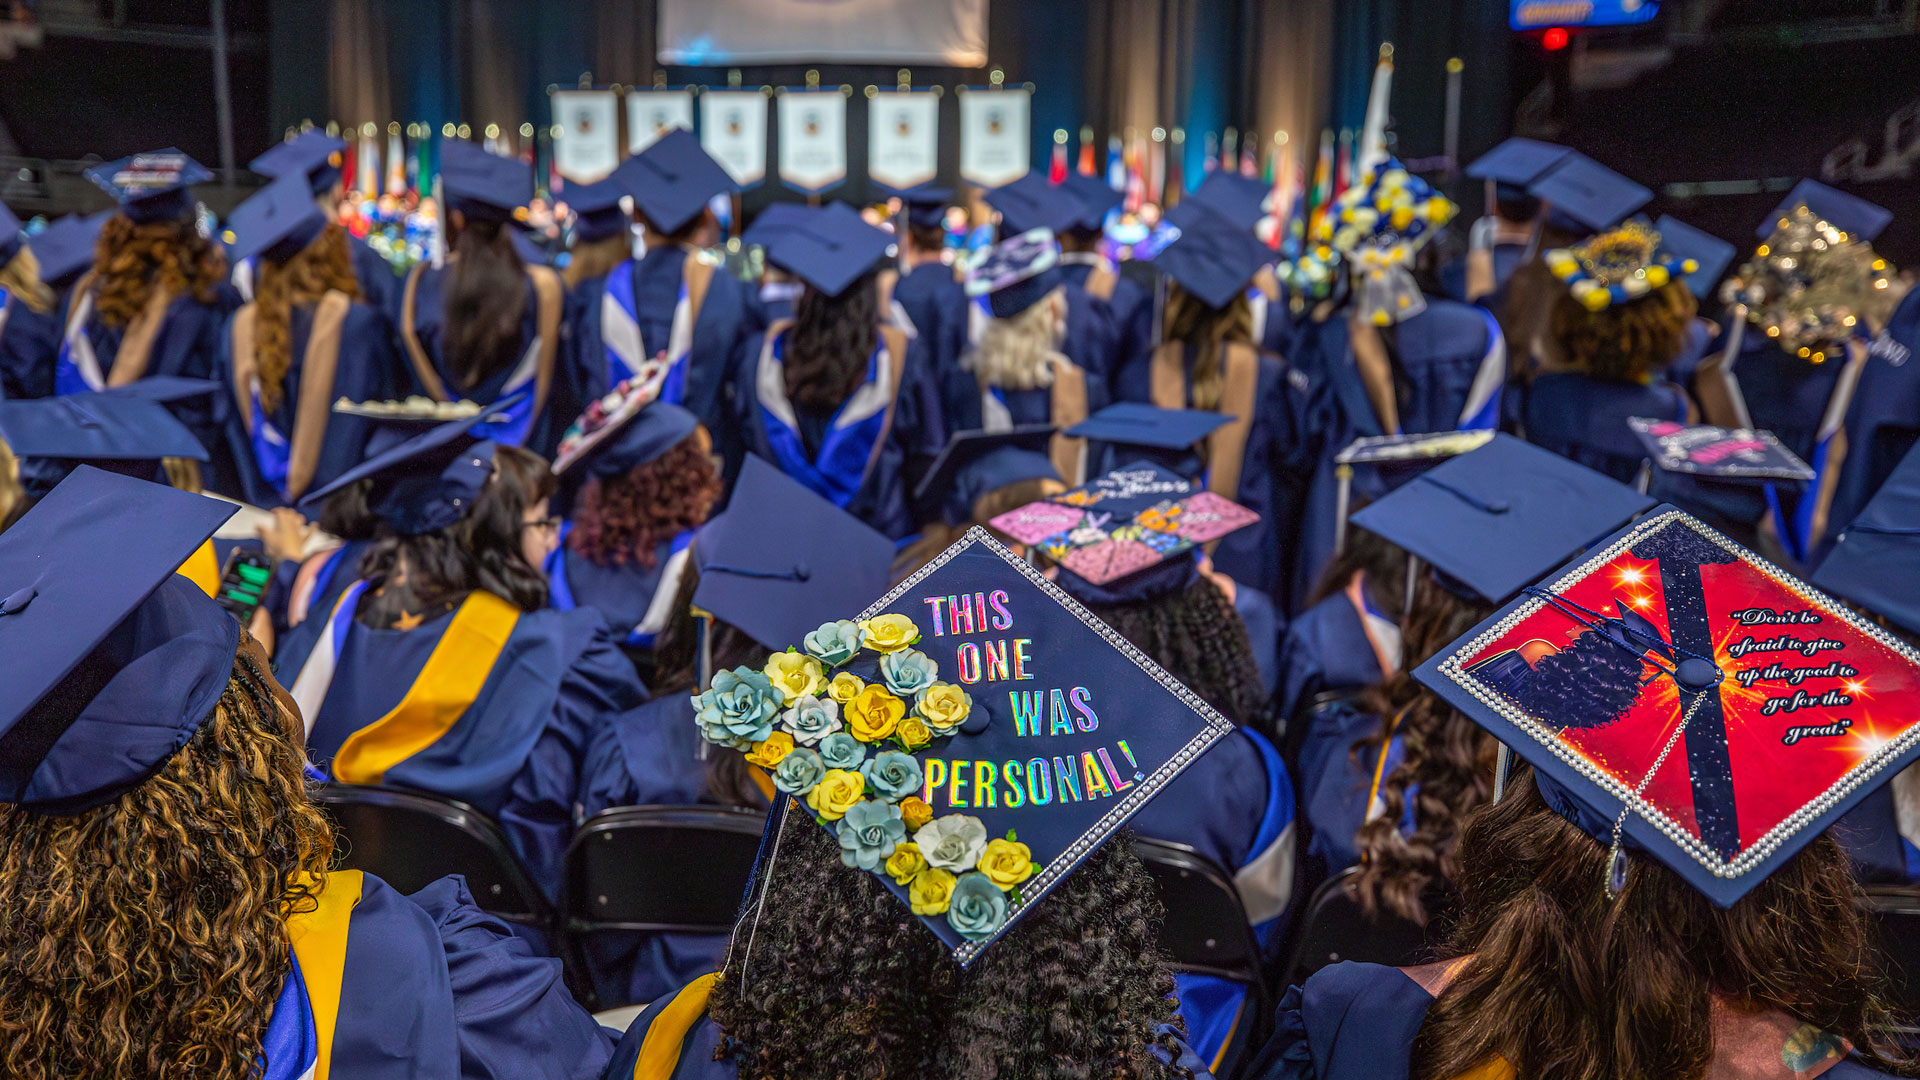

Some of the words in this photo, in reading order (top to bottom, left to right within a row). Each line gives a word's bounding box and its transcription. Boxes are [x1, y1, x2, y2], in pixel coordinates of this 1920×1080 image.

[924, 590, 1013, 637] THIS
[1801, 611, 1818, 623] be
[1729, 637, 1786, 658] afraid
[1789, 641, 1802, 651] to
[1803, 639, 1842, 656] give
[957, 638, 1034, 684] ONE
[1738, 670, 1759, 687] up
[1765, 666, 1790, 679] the
[1790, 664, 1837, 684] good
[1839, 668, 1855, 678] to
[1009, 686, 1099, 737] WAS
[1762, 698, 1788, 715] go
[1785, 690, 1817, 713] for
[1823, 692, 1849, 704] the
[1784, 720, 1850, 745] great."
[922, 739, 1144, 809] PERSONAL!
